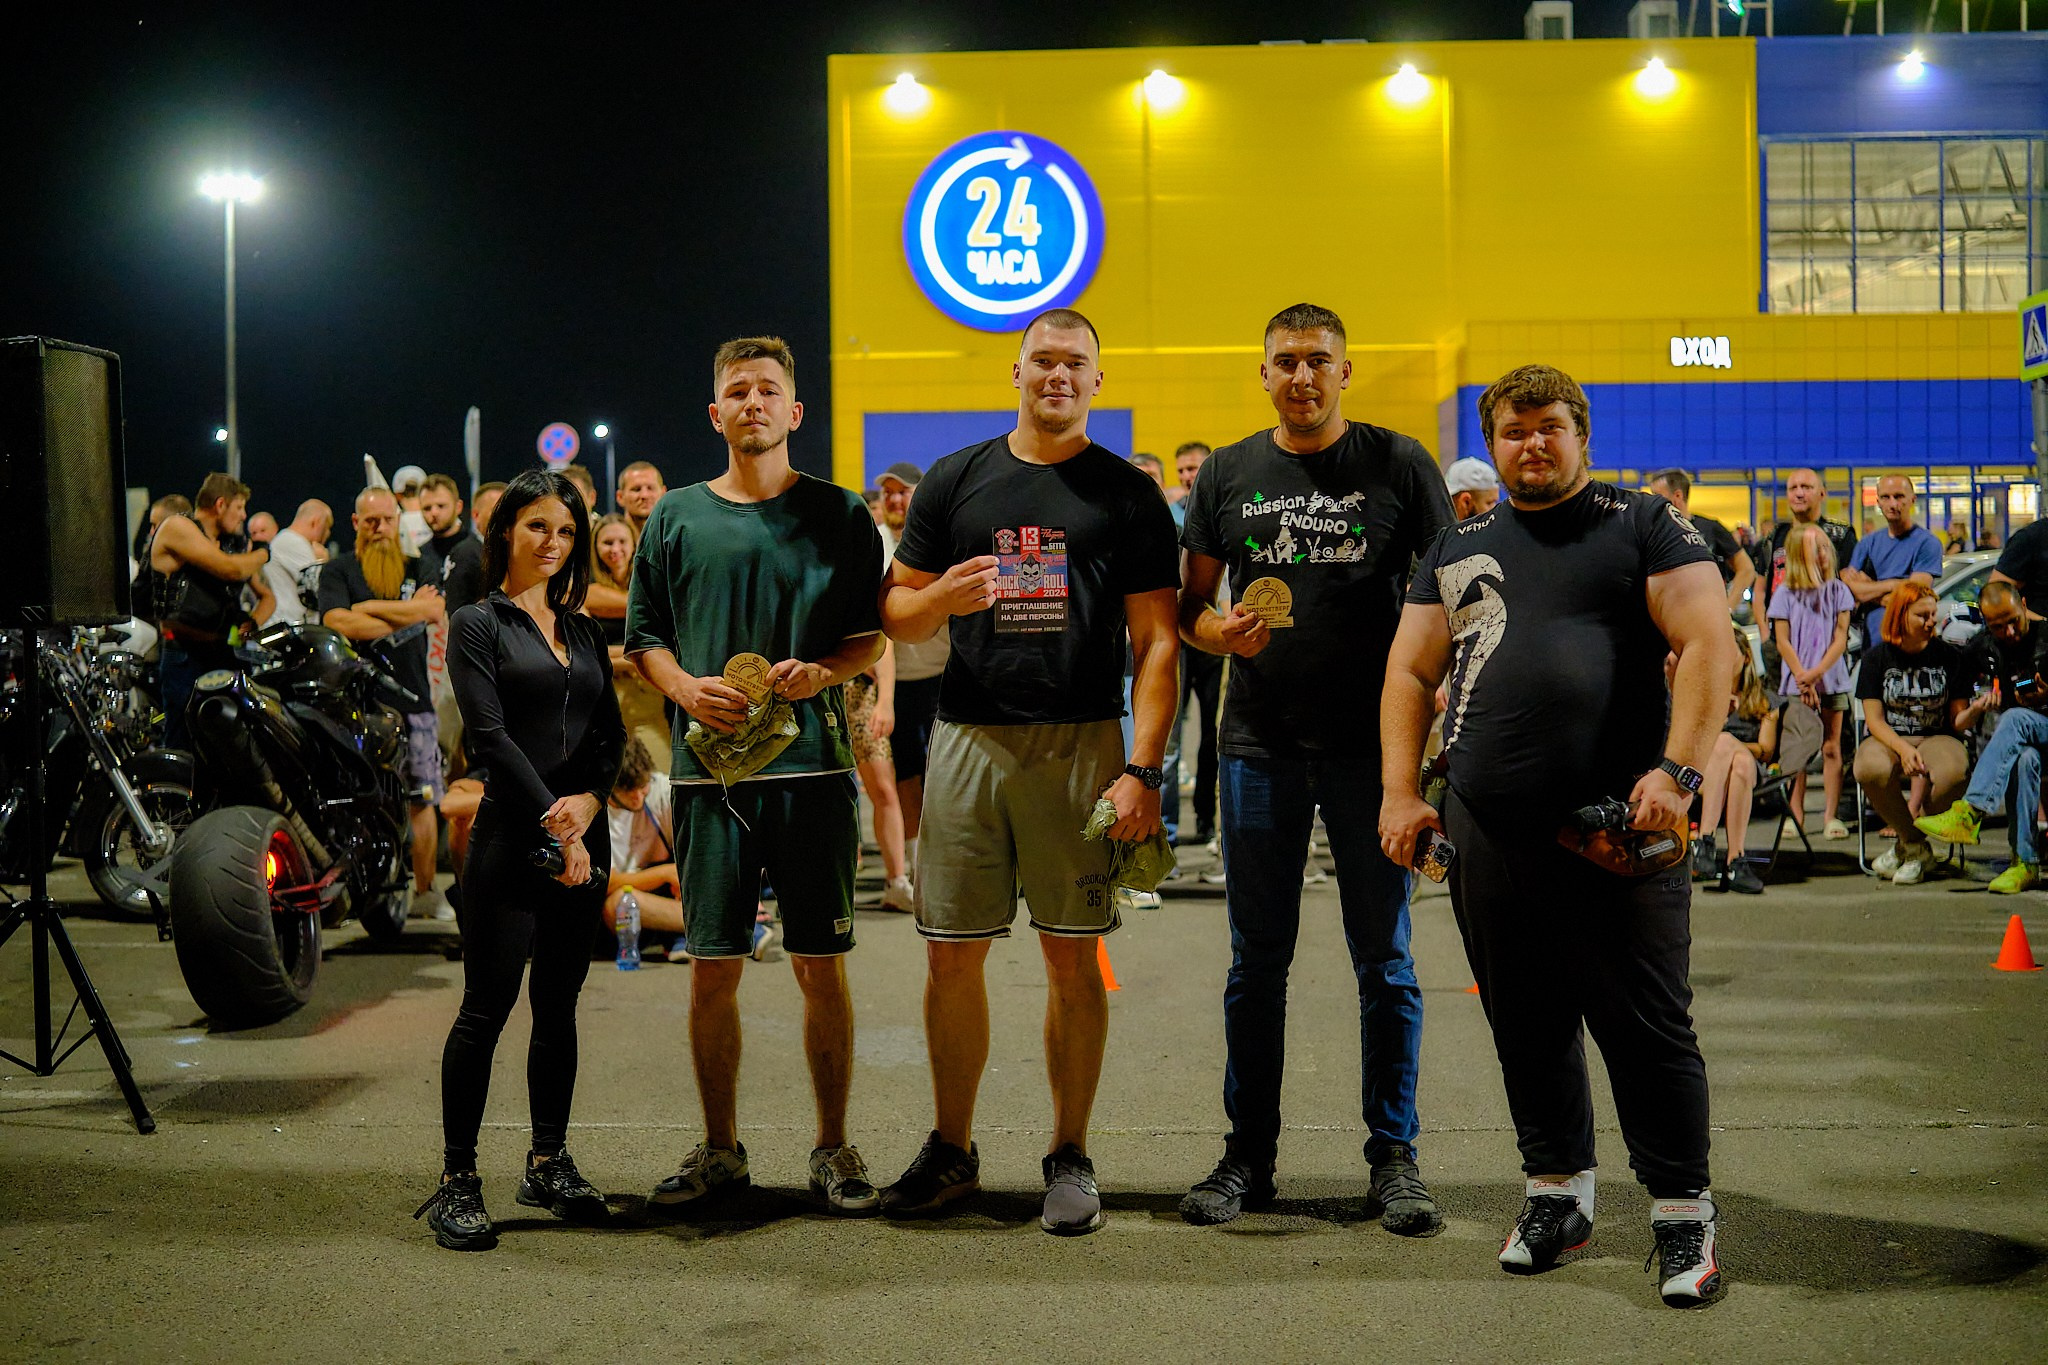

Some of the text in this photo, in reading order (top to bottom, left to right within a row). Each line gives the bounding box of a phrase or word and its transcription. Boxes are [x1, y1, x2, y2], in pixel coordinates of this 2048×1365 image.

[966, 176, 1042, 247] 24
[966, 249, 1042, 285] ЧАСА
[1670, 336, 1732, 369] ВХОД
[1242, 495, 1305, 519] Russian
[1279, 510, 1348, 535] ENDURO
[1021, 527, 1039, 545] 13
[996, 573, 1066, 590] ROCK ROLL
[996, 589, 1066, 598] В РАЮ 2024
[1001, 602, 1064, 611] ПРИГЛАШЕНИЕ
[1012, 613, 1028, 621] ДВЕ
[1087, 889, 1102, 907] 35
